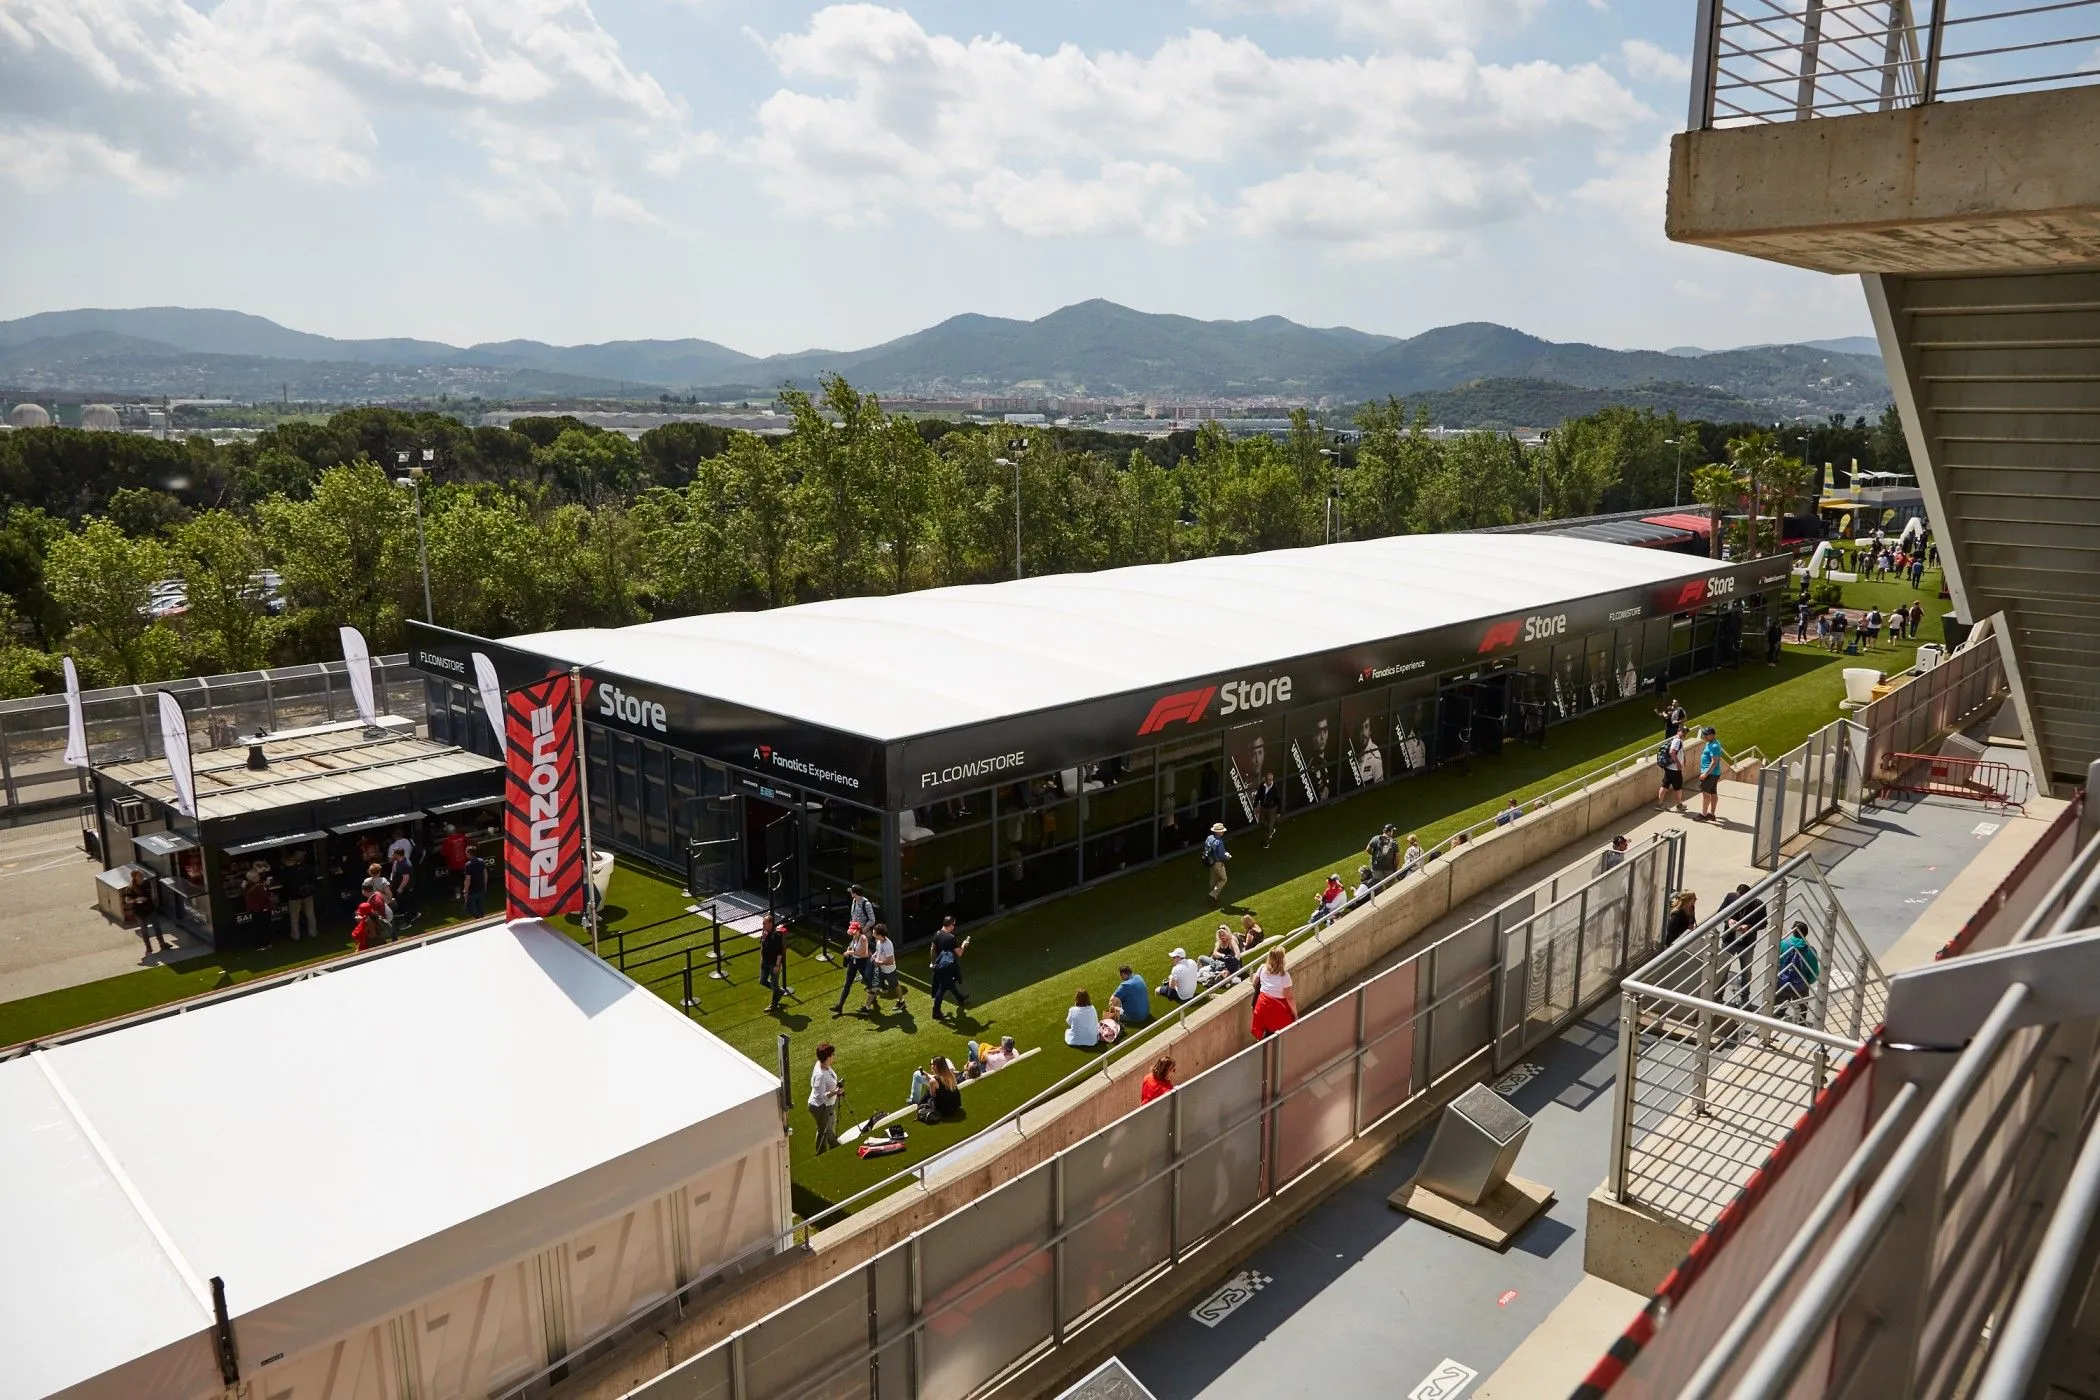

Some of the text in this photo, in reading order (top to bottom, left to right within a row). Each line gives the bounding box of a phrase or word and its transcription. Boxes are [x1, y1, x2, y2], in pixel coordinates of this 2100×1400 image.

[1706, 576, 1735, 598] Store
[1524, 614, 1567, 642] Store
[1358, 659, 1426, 683] A Fanatics Experience
[598, 683, 667, 733] Store
[1220, 676, 1292, 716] Store
[753, 748, 859, 789] A Fanatics Experience
[920, 751, 1025, 789] F1.COM/STORE
